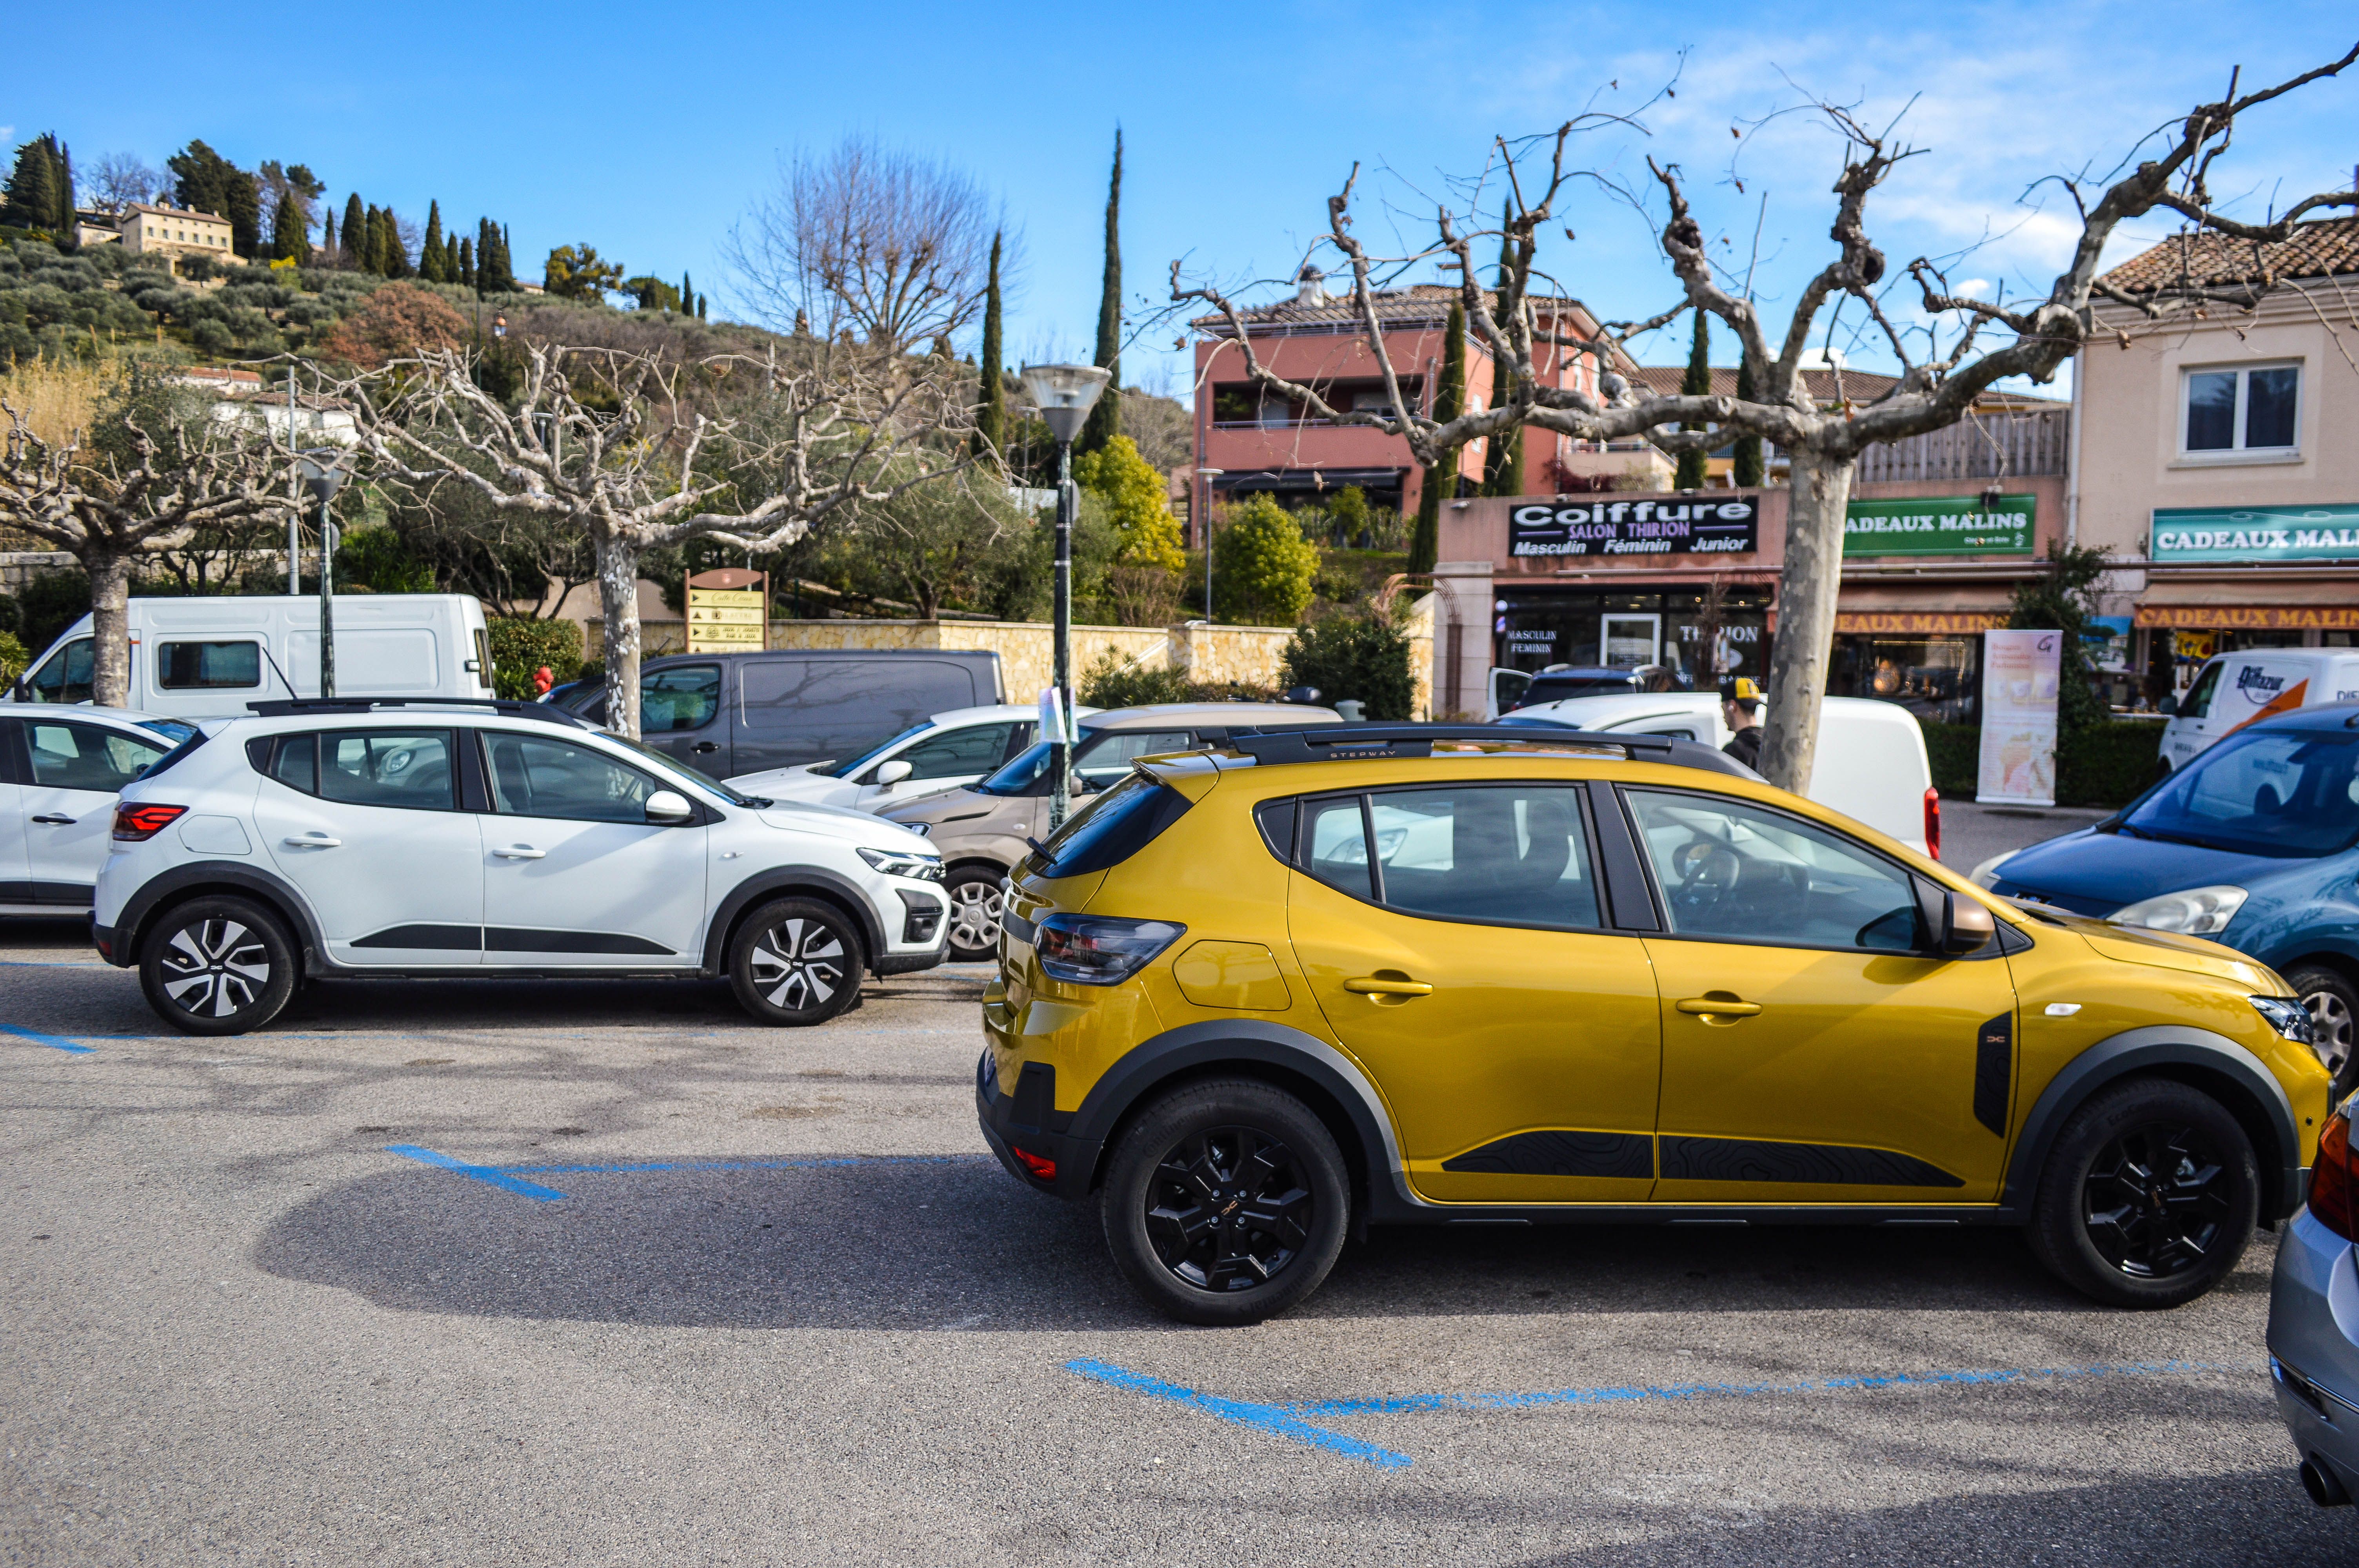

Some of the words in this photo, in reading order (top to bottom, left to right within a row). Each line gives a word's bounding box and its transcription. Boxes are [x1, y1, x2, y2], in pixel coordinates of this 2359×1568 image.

[1514, 501, 1752, 526] Coiffure
[1845, 515, 1935, 532] ADEAUX
[1939, 513, 2026, 530] MALINS
[1568, 524, 1617, 539] SALON
[1627, 522, 1690, 537] THIRION
[2157, 530, 2289, 550] CADEAUX
[1514, 540, 1587, 556] Masculin
[1603, 538, 1671, 554] Féminin
[1690, 537, 1748, 552] Junior
[2139, 609, 2270, 625] CADEAUX
[1507, 630, 1556, 640] MASCULIN
[1143, 1104, 1212, 1159] Continental
[1249, 1259, 1318, 1314] Continental
